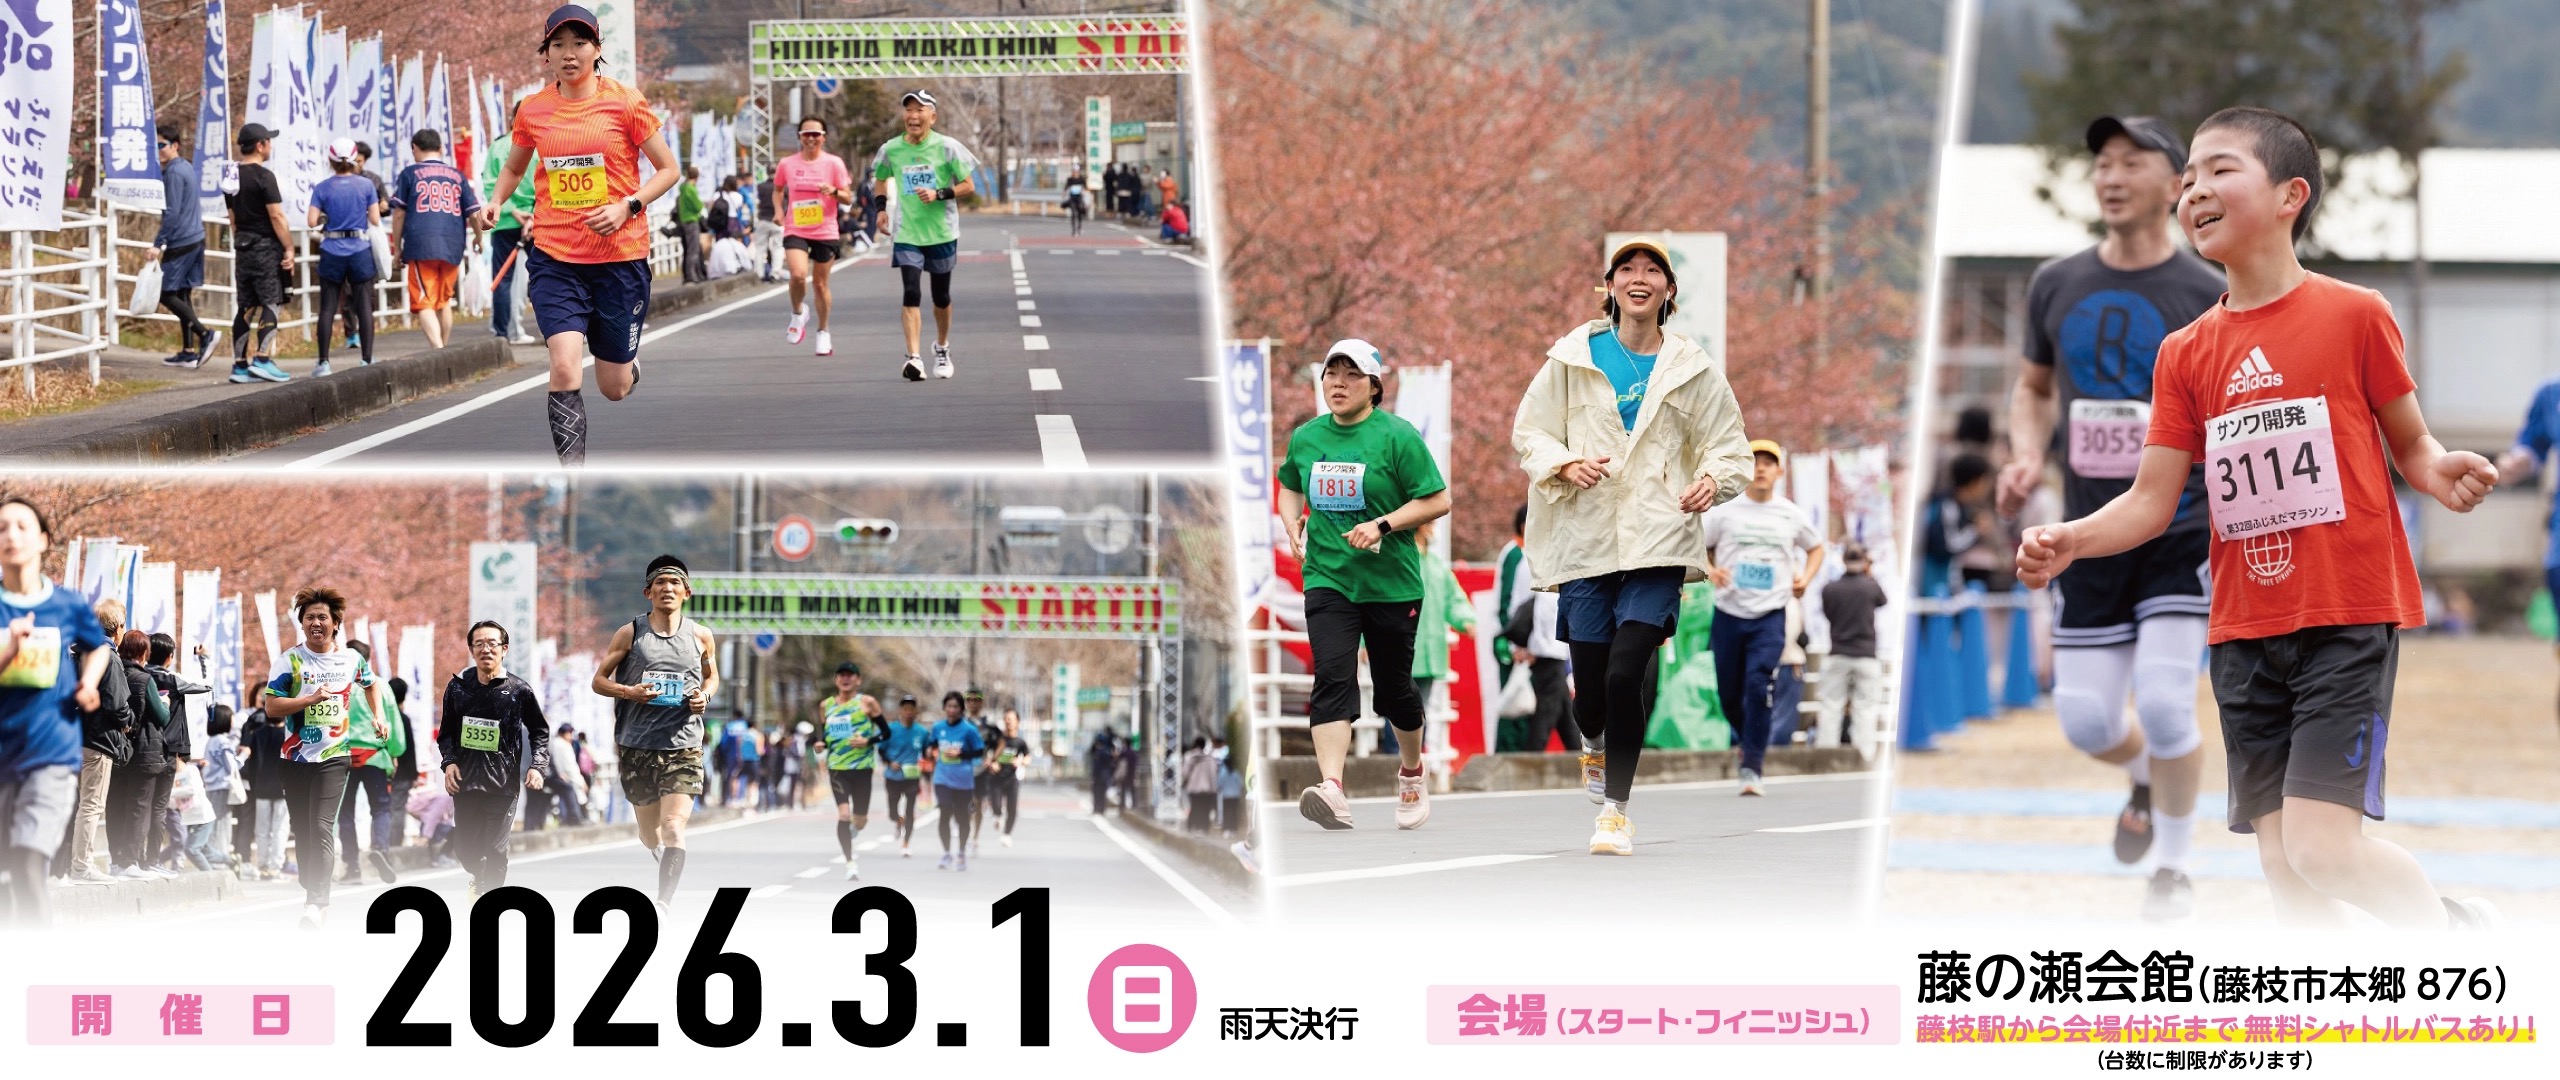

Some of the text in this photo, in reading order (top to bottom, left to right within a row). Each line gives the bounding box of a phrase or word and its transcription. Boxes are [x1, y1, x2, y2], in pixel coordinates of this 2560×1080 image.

[894, 31, 1057, 64] MARATHON
[551, 157, 595, 168] サンワ開発
[558, 172, 594, 193] 506
[907, 174, 933, 188] 1642
[416, 180, 462, 216] 2896
[800, 206, 817, 218] 503
[2226, 372, 2284, 397] adidas
[2217, 405, 2307, 442] サンワ開発
[2081, 425, 2142, 455] 3055
[1321, 464, 1357, 474] サンワ開発
[2216, 441, 2321, 502] 3114
[1317, 478, 1357, 497] 1813
[2226, 507, 2329, 535] 第32回ふじえだマラソン
[649, 672, 678, 680] サンワ開発
[309, 704, 339, 717] 5329
[465, 728, 495, 742] 5355
